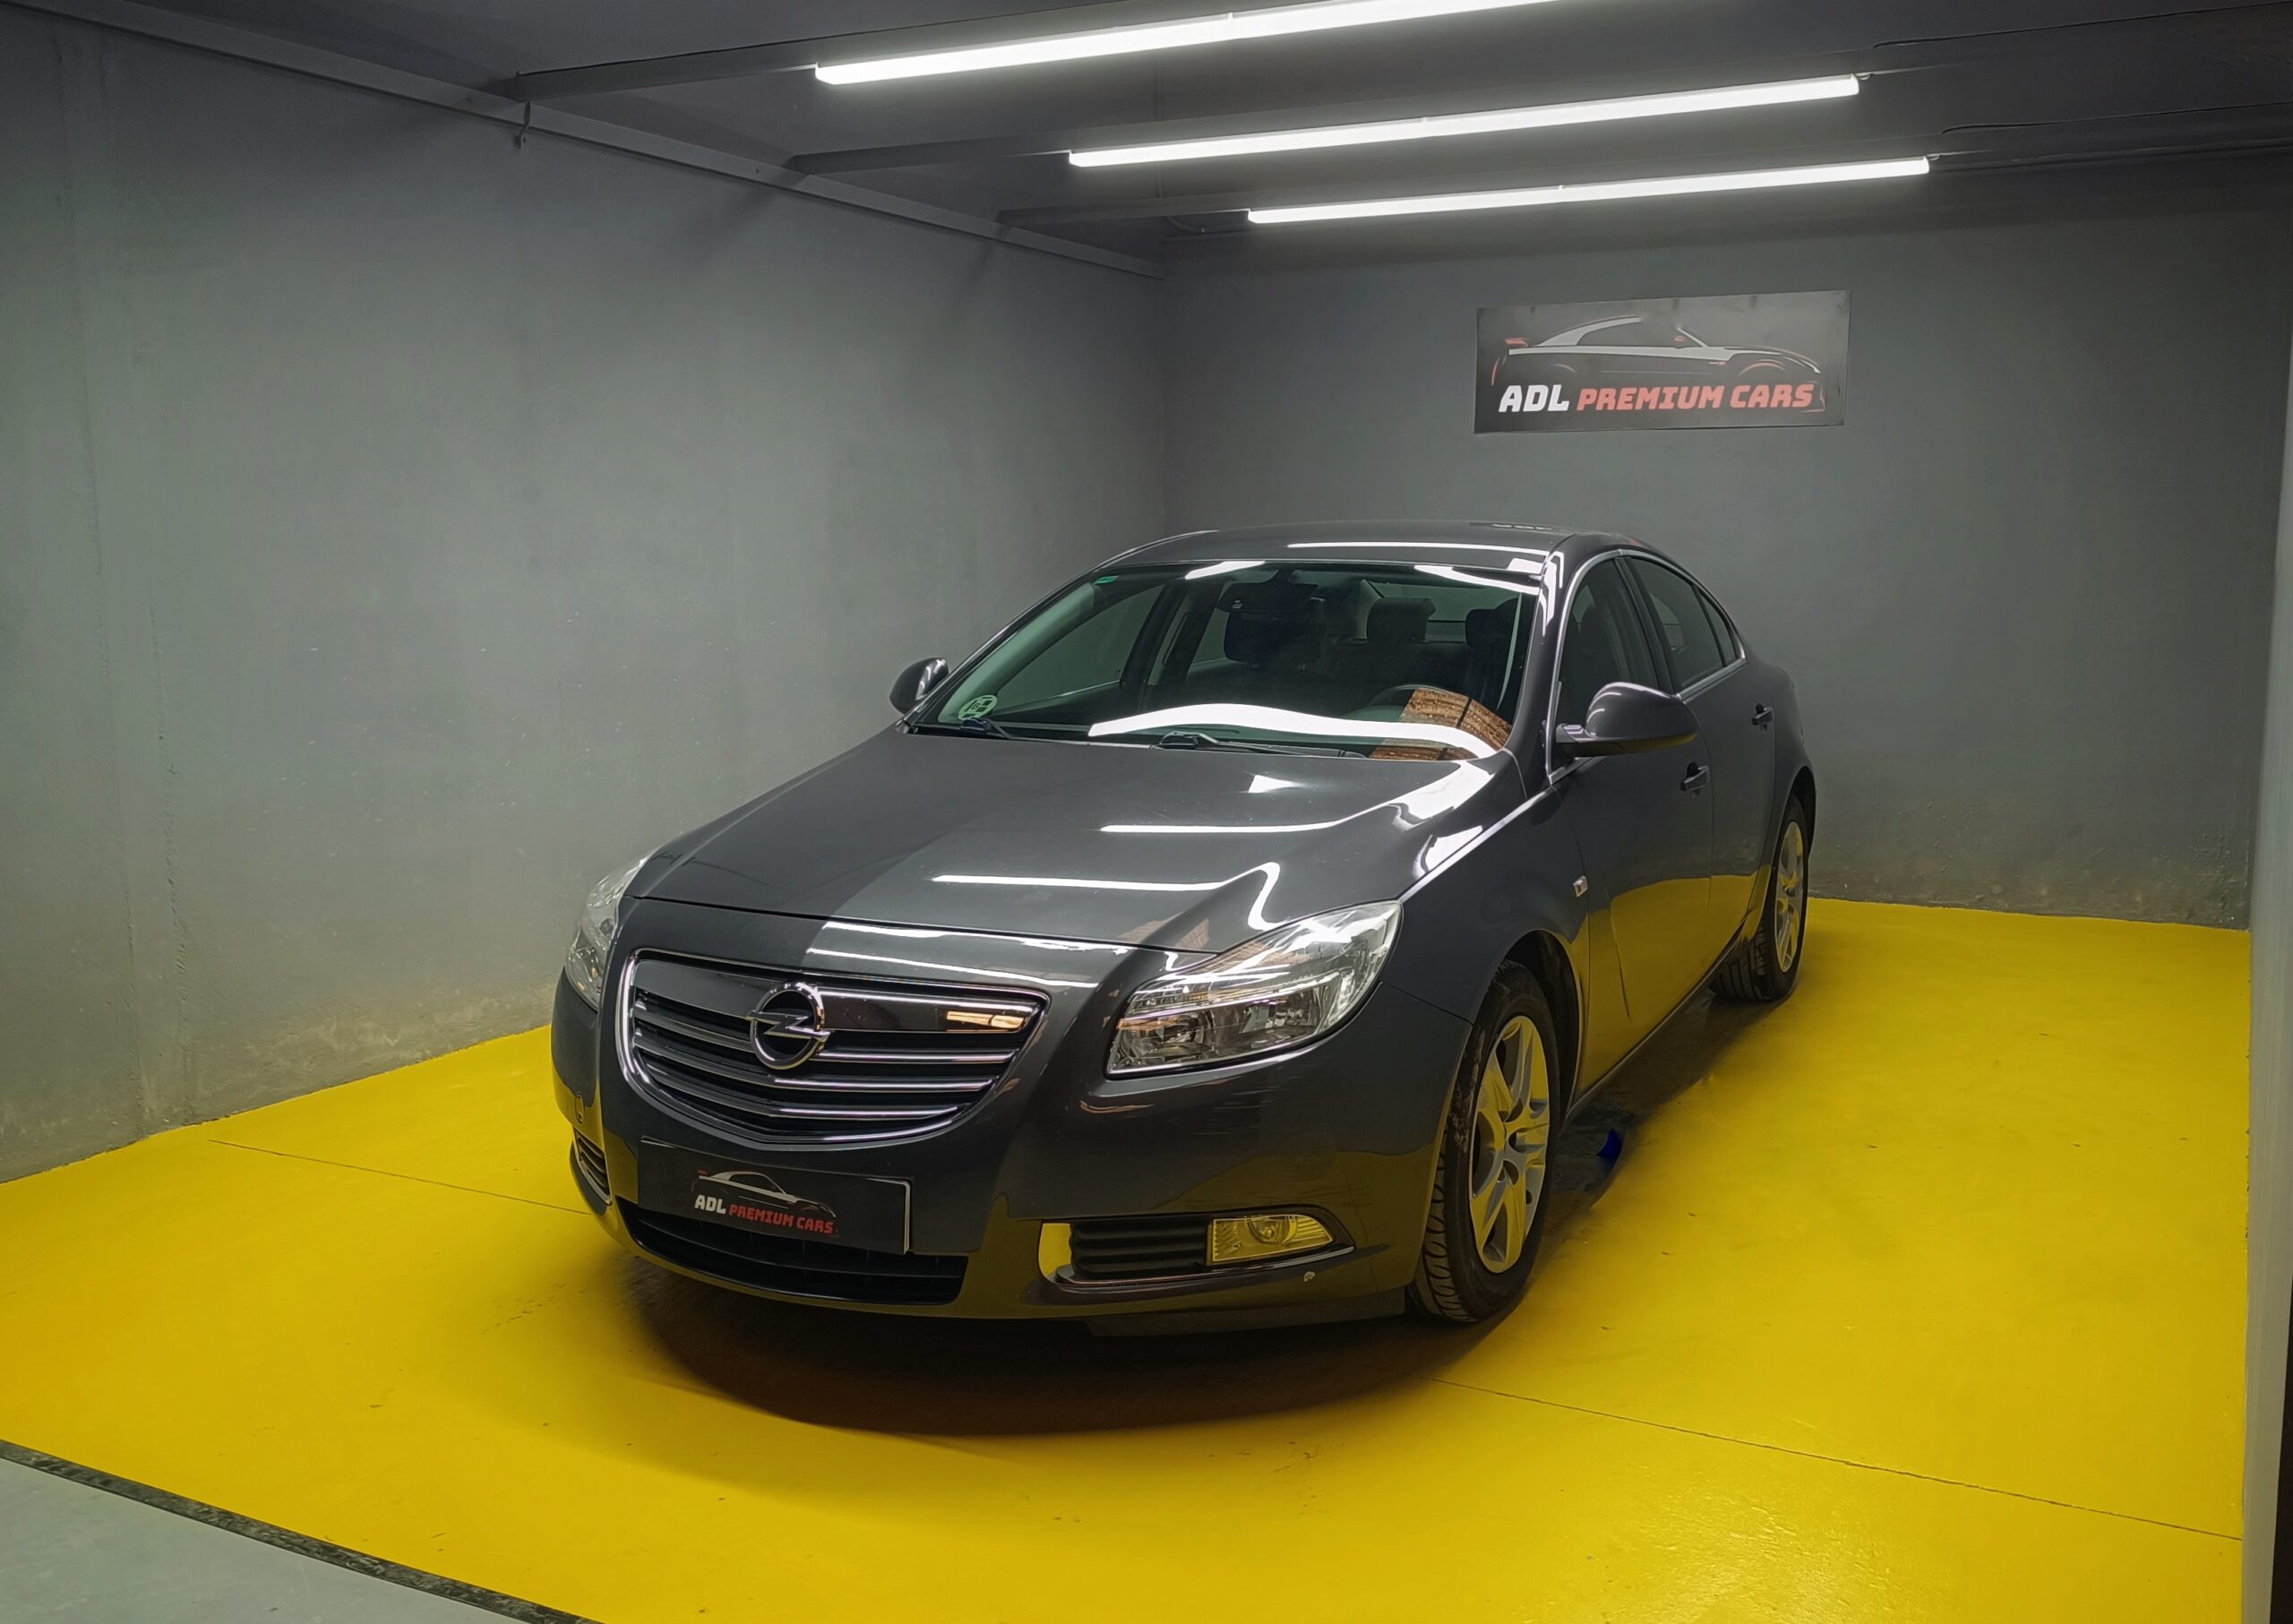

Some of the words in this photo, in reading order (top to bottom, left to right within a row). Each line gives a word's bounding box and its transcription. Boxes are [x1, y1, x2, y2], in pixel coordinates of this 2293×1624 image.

[1499, 384, 1569, 413] ADL
[1576, 386, 1725, 410] PREMIUM
[1730, 384, 1815, 408] CARS
[694, 1194, 726, 1215] ADL
[728, 1204, 794, 1226] PREMIUM
[795, 1216, 834, 1233] CARS
